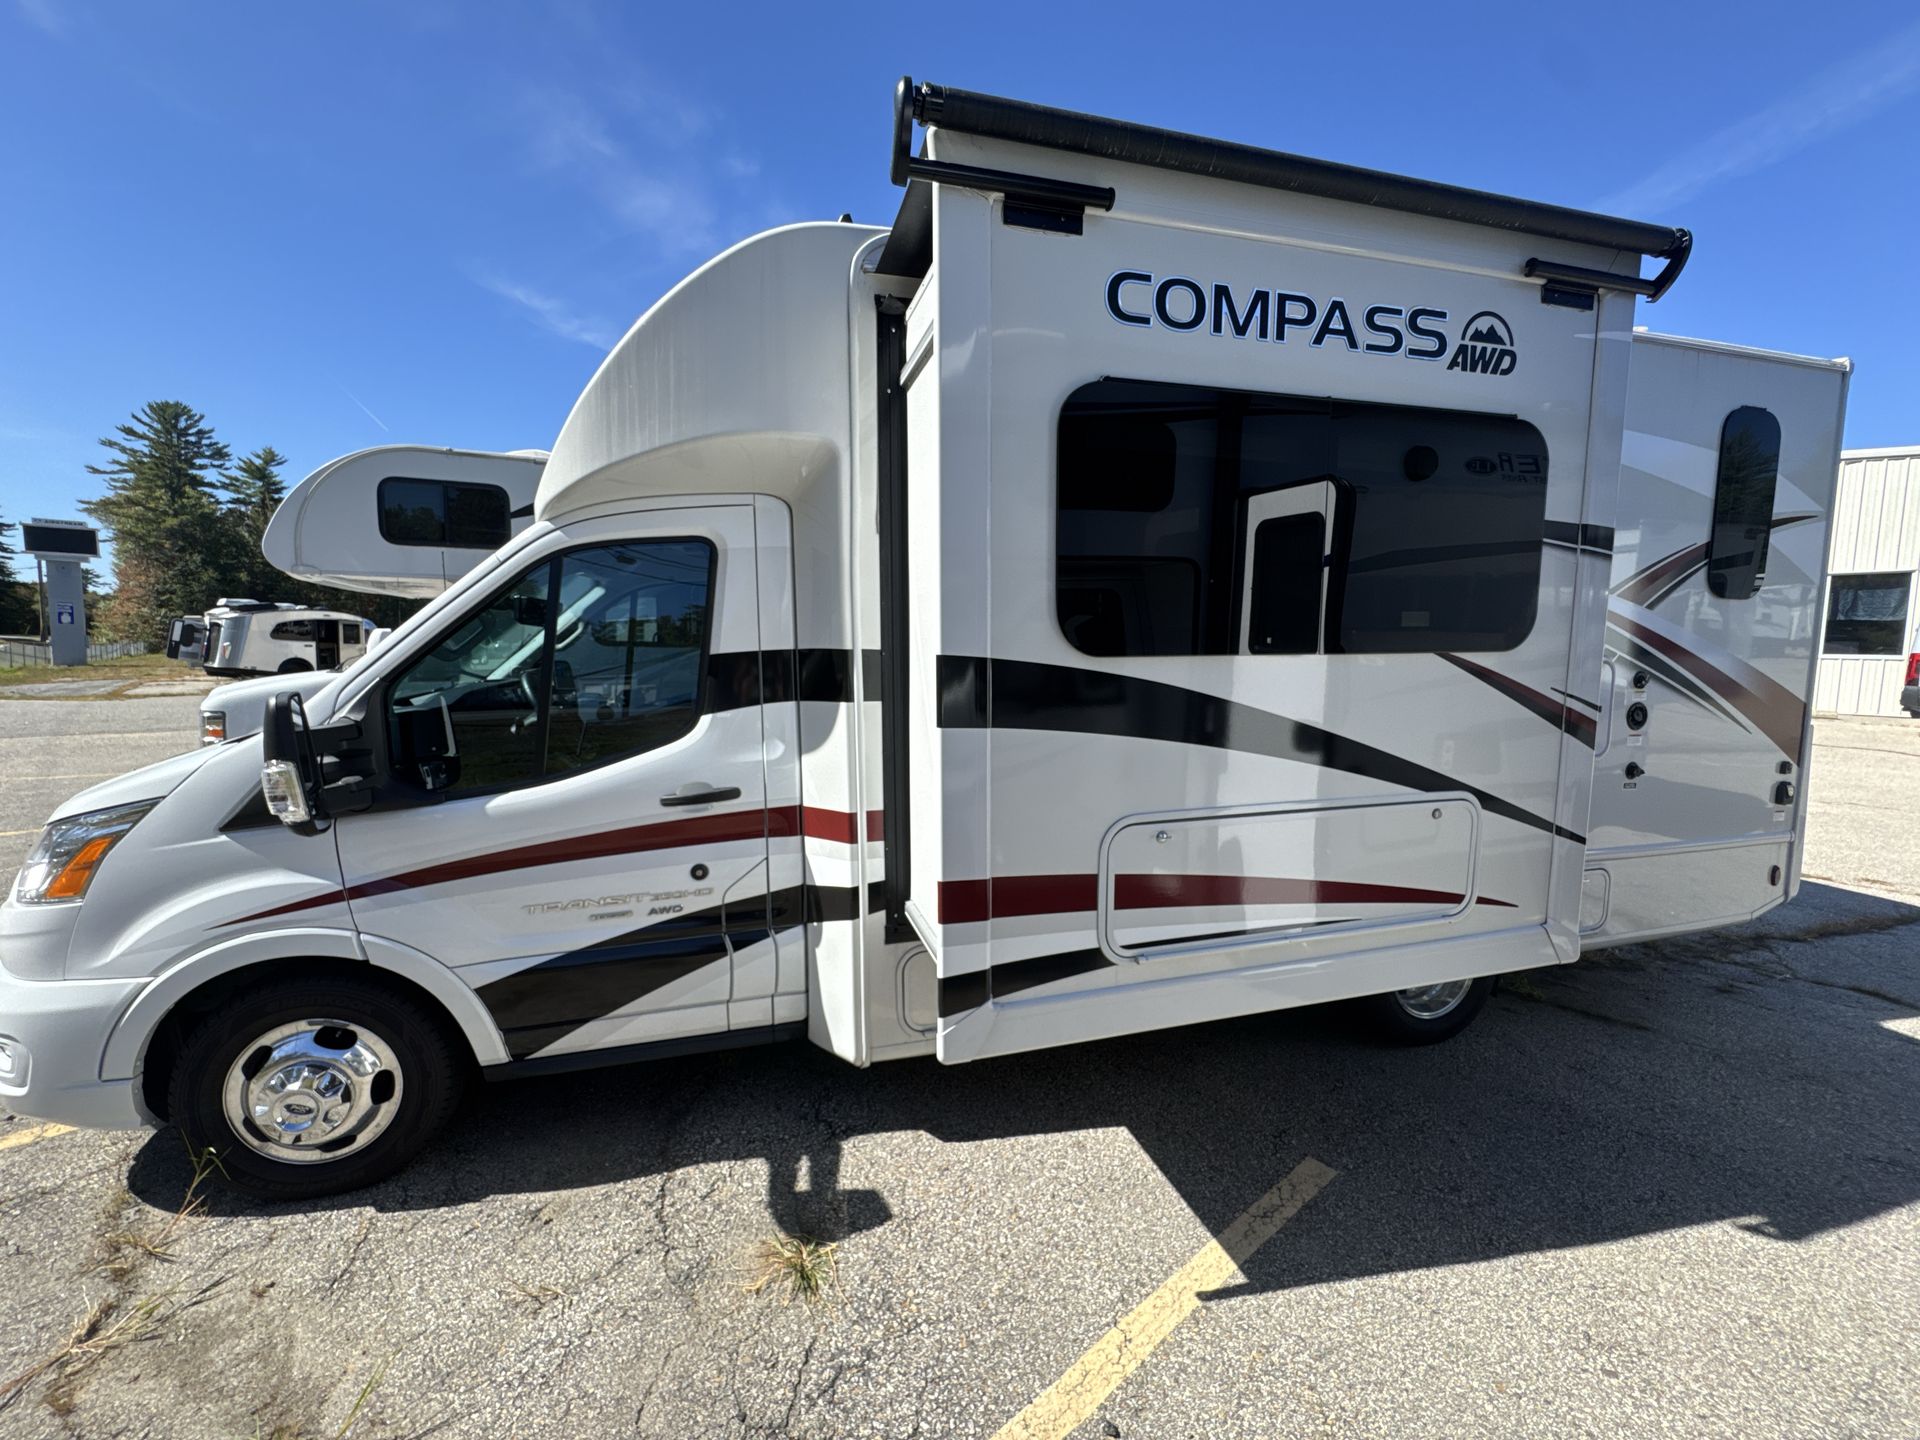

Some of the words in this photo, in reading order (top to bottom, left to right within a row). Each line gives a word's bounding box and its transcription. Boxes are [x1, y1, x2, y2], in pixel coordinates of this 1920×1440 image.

[1105, 269, 1449, 361] COMPASS
[1447, 344, 1517, 376] AWD
[521, 892, 650, 914] TRANSIT
[648, 904, 684, 916] AWD
